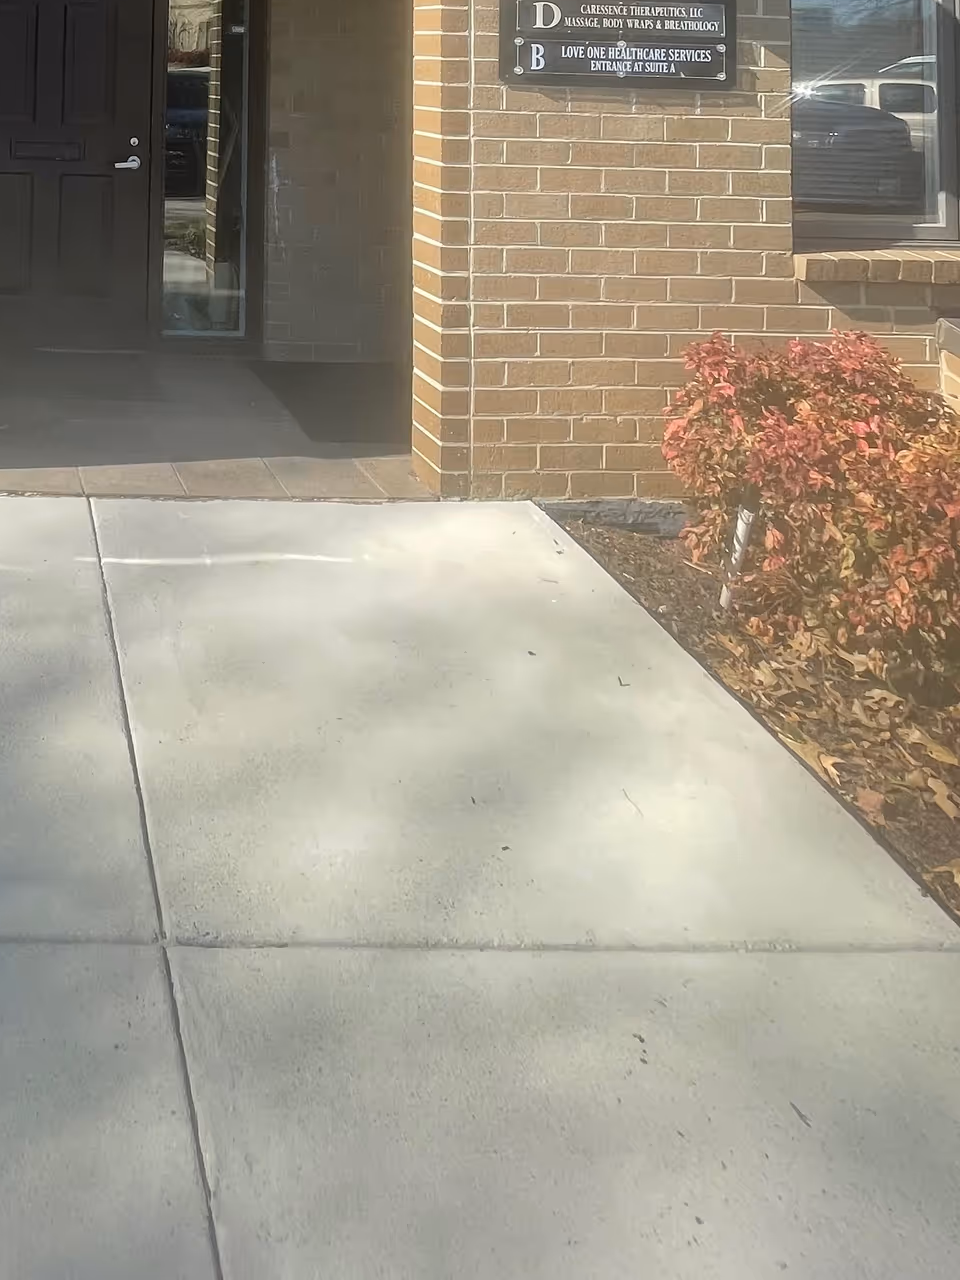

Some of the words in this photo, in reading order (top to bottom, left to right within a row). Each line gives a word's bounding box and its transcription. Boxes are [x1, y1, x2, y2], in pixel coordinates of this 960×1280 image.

[532, 1, 562, 29] D
[580, 4, 628, 16] CARESSENCE
[630, 6, 688, 19] THERAPEUTICS,
[689, 7, 704, 18] LLC
[563, 16, 601, 28] MASSAGE,
[602, 18, 624, 29] BODY
[626, 19, 654, 30] WRAPS
[655, 20, 662, 30] &
[664, 20, 720, 32] BREATHOLOGY
[530, 43, 546, 70] B
[561, 45, 585, 58] LOVE
[587, 46, 606, 59] ONE
[608, 47, 667, 61] HEALTHCARE
[668, 48, 712, 62] SERVICES
[590, 60, 632, 72] ENTRANCE
[633, 61, 644, 72] AT
[644, 61, 669, 73] SUITE
[669, 62, 676, 73] A
